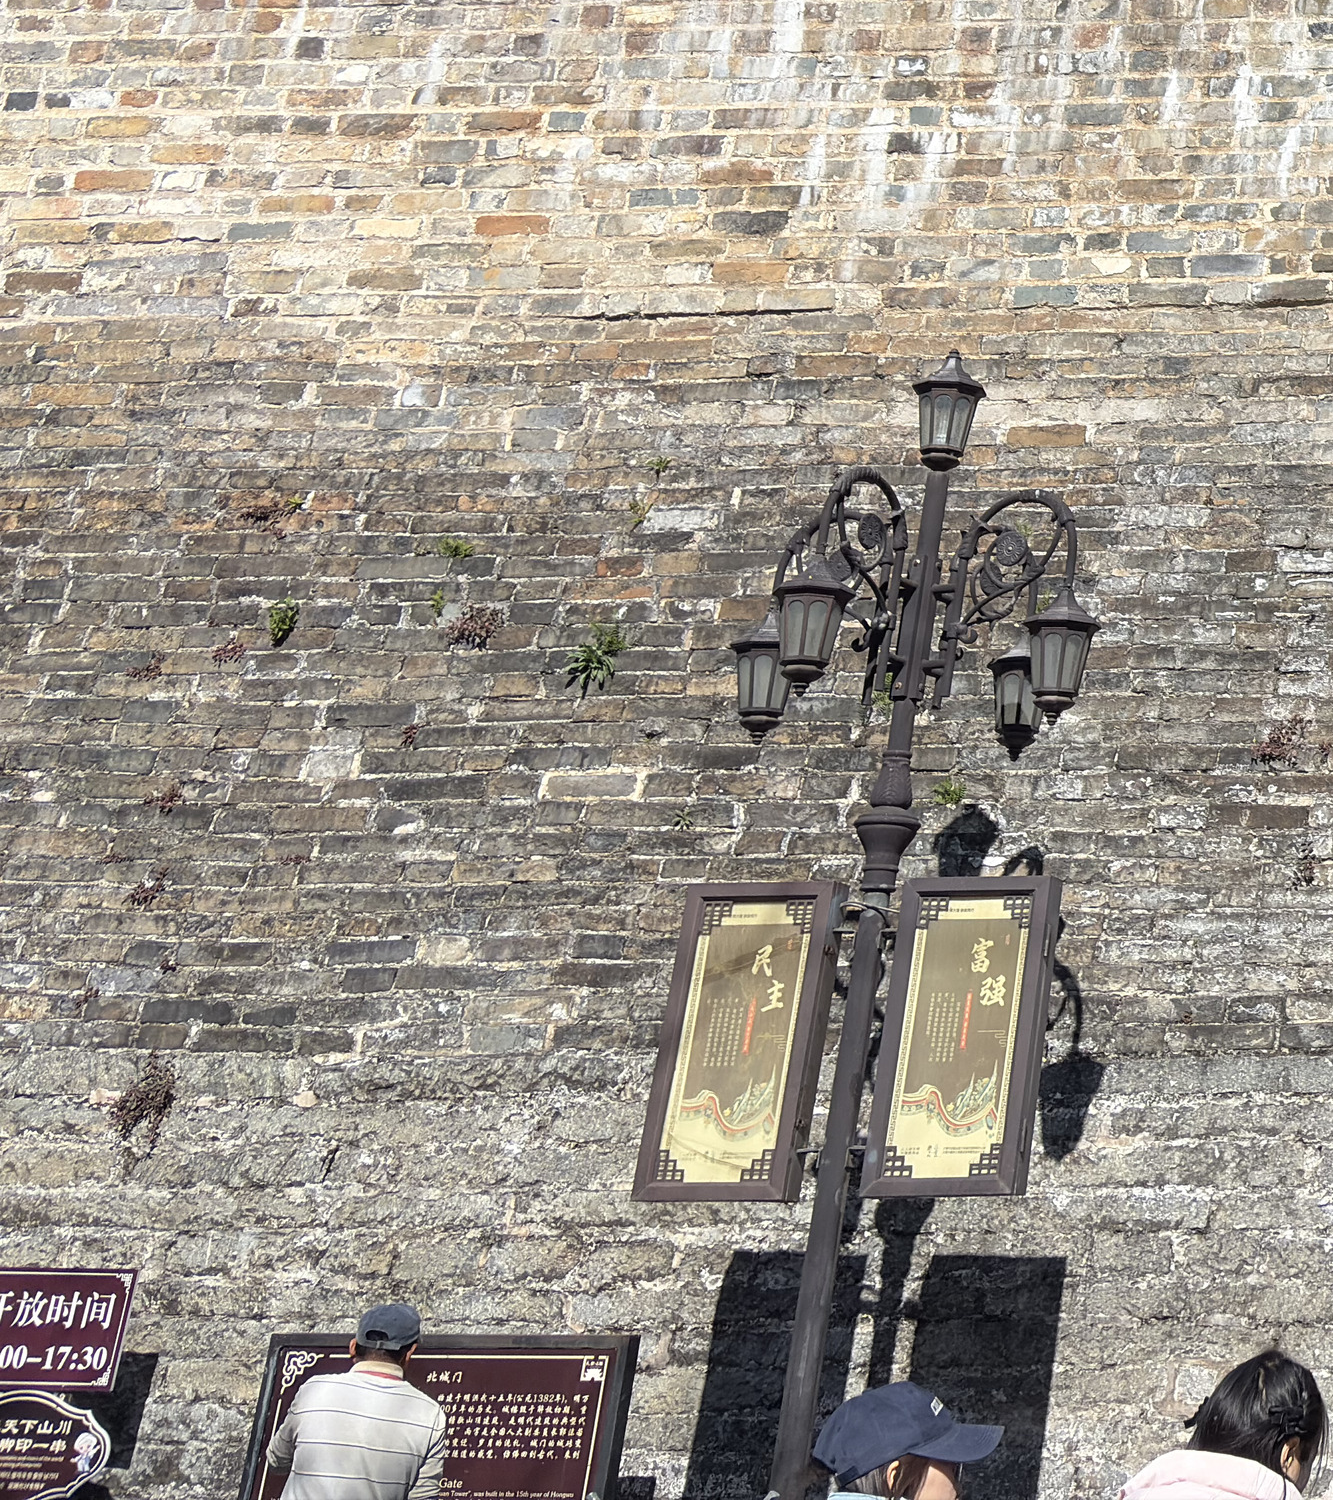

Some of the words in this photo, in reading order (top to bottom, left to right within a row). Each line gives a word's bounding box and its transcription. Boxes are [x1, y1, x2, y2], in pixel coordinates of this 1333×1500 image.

[750, 944, 785, 1013] 民主
[970, 937, 1008, 1008] 富强
[0, 1291, 117, 1330] 开放时间
[426, 1371, 463, 1384] 北城门
[0, 1420, 72, 1435] 天下山川
[0, 1438, 66, 1454] 脚印一串
[439, 1477, 463, 1488] Gate
